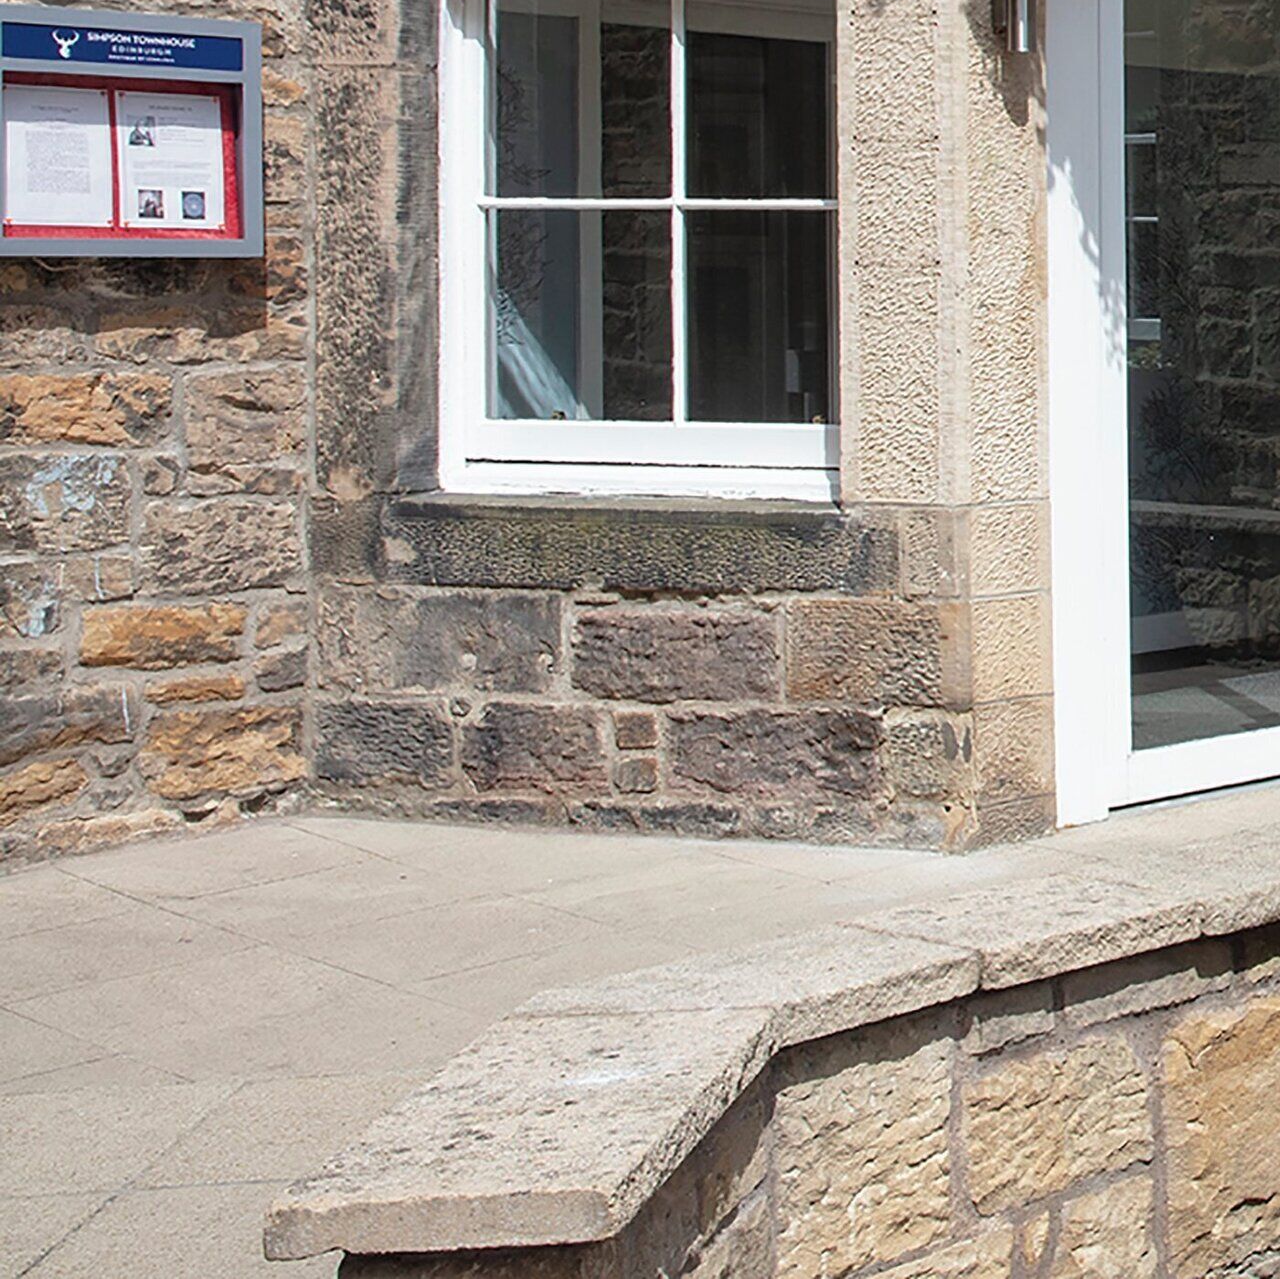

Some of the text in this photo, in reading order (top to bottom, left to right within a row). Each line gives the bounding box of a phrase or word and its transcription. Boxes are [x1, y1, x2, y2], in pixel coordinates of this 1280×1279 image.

[87, 31, 196, 48] SIMPSON TOWNHOUSE
[111, 45, 172, 56] EDINBURGH
